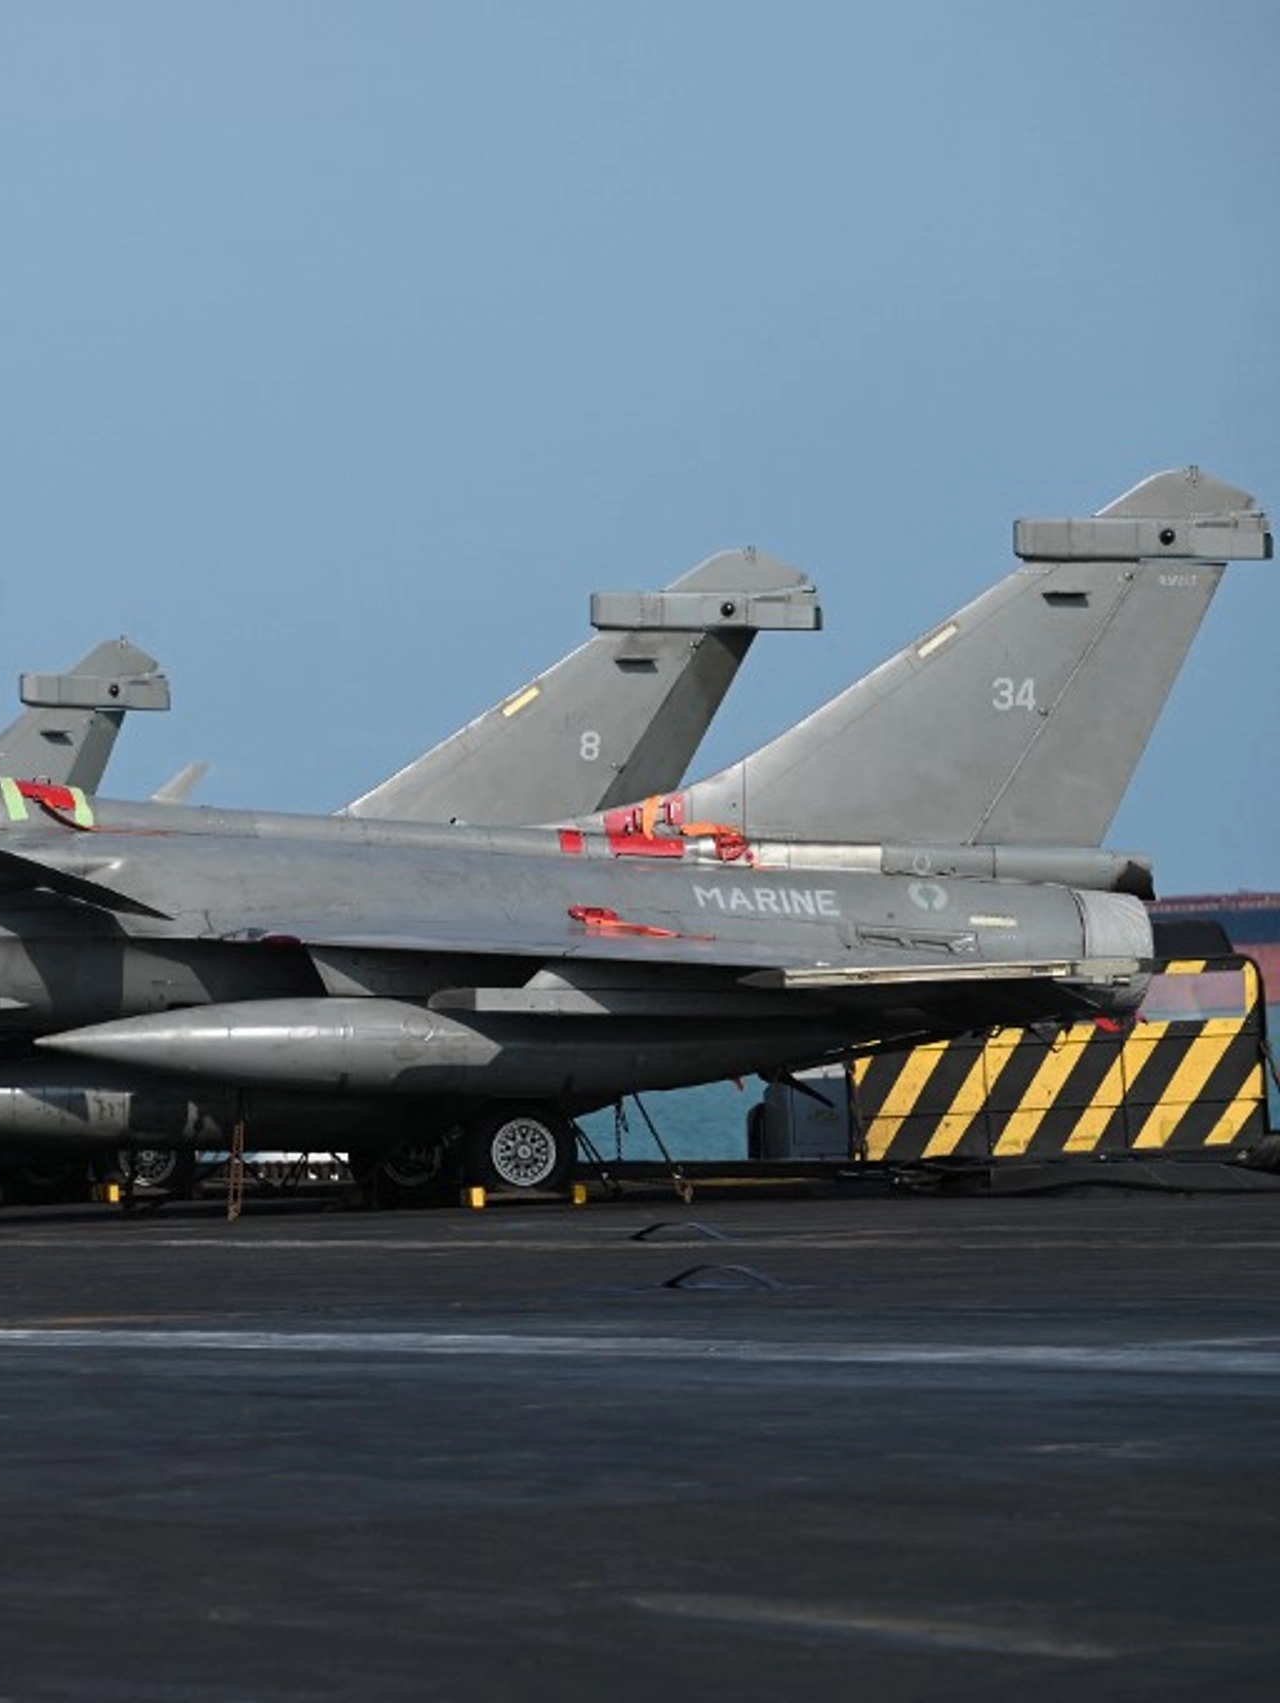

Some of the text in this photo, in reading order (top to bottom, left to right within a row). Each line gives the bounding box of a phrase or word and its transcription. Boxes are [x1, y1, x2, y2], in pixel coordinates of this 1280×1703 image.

[992, 677, 1036, 711] 34
[580, 730, 601, 761] 8
[692, 884, 841, 917] MARINE
